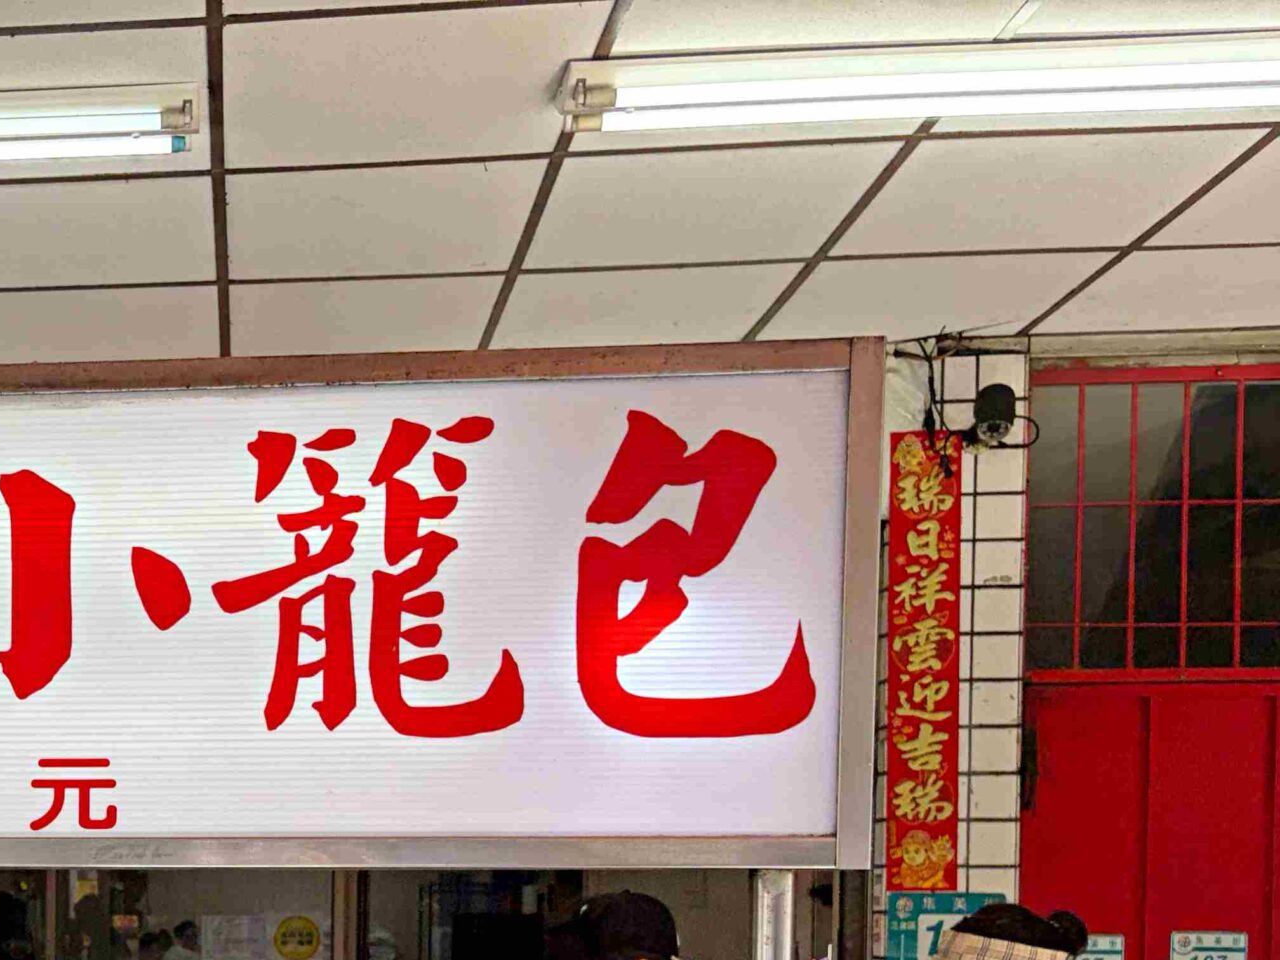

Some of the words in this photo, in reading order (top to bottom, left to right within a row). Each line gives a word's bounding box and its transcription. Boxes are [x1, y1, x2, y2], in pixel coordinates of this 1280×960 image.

[892, 466, 956, 823] 瑞日祥雲迎吉瑞
